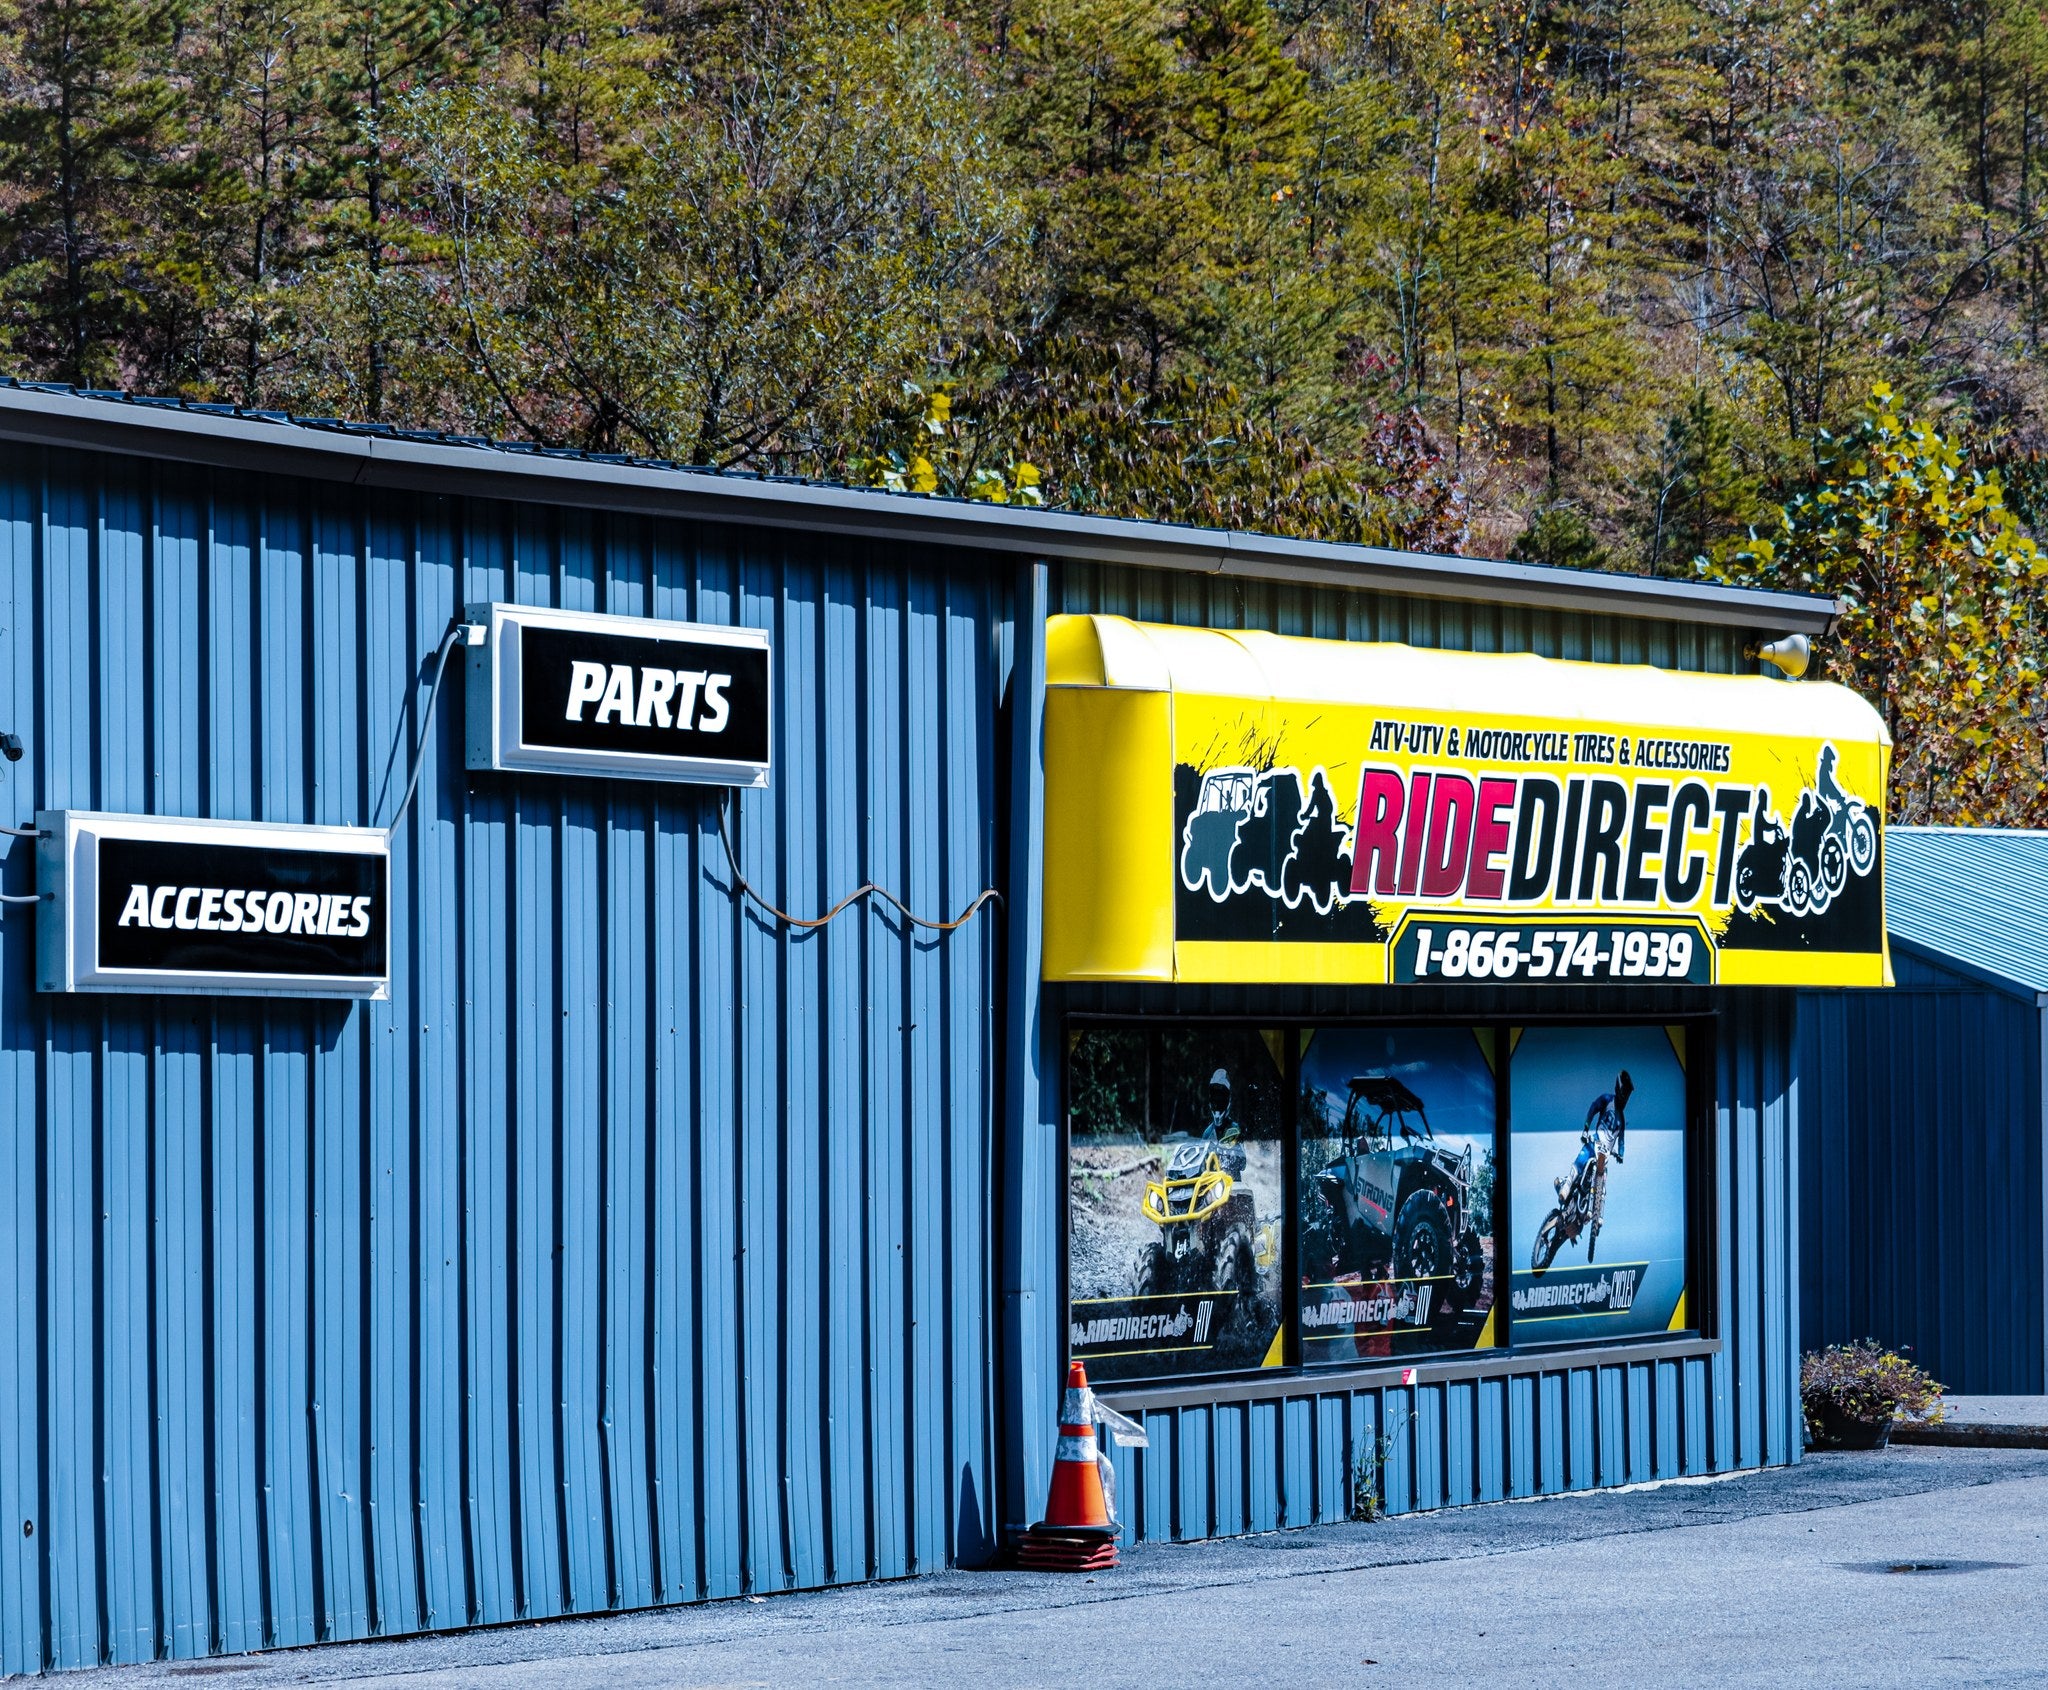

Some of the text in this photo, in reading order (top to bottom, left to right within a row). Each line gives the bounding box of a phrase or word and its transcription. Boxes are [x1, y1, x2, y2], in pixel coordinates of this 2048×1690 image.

[565, 660, 732, 733] PARTS
[1369, 721, 1731, 772] ATV-UTV & MOTORCYCLE TIRES & ACCESSORIES
[118, 884, 371, 937] ACCESSORIES
[1413, 928, 1694, 978] 1-866-574-1939
[1319, 1285, 1433, 1326] RIDEDIRECT UTV
[1526, 1269, 1636, 1309] RIDEDIRECT CYCLES
[1086, 1300, 1214, 1343] RIDEDIRECT ATV
